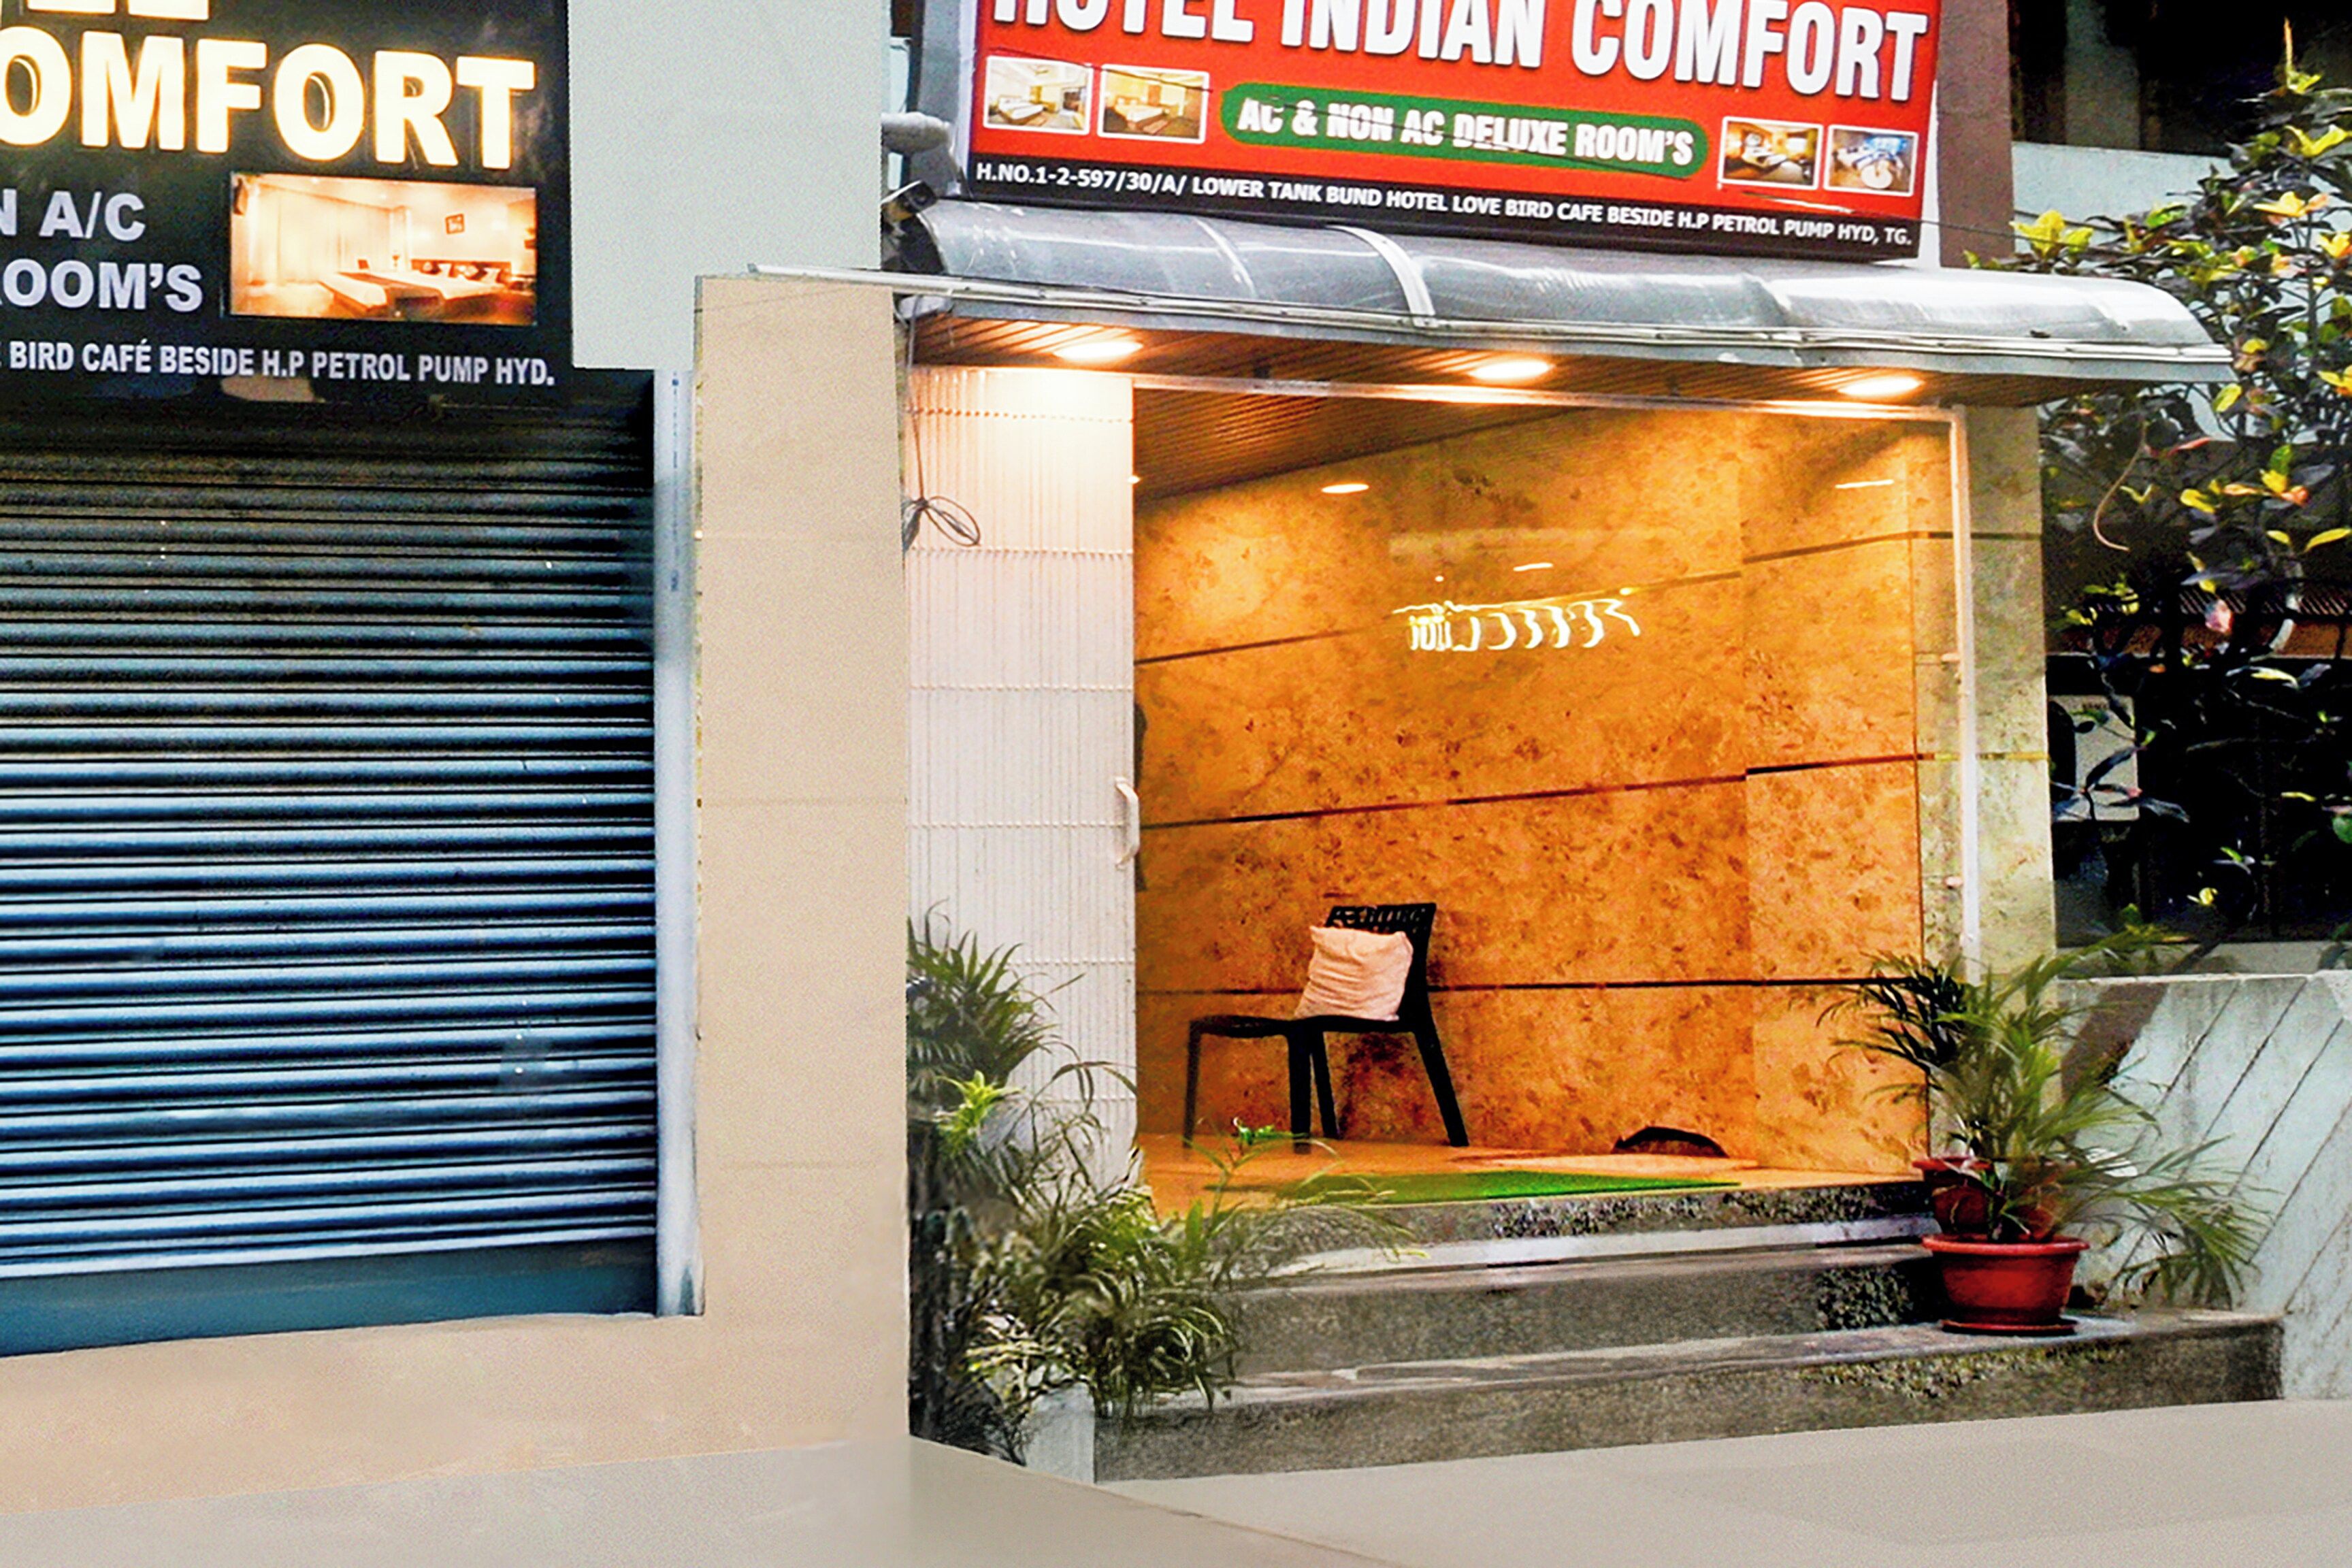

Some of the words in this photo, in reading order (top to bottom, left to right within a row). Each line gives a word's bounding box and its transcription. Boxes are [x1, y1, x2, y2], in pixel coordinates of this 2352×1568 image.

[1281, 0, 1544, 68] INDIAN
[1571, 0, 1928, 101] COMFORT
[1237, 97, 1284, 133] AC
[1292, 99, 1318, 136] &
[1326, 103, 1394, 141] NON
[1400, 109, 1446, 146] AC
[1453, 113, 1568, 155] DELUXE
[1573, 123, 1694, 165] ROOM'S
[39, 191, 146, 242] A/C
[1192, 176, 1264, 198] LOWER
[1268, 181, 1322, 202] TANK
[1326, 185, 1382, 206] BUND
[1386, 190, 1448, 212] HOTEL
[1452, 195, 1501, 215] LOVE
[1505, 199, 1554, 219] BIRD
[1557, 203, 1602, 222] CAFE
[1607, 206, 1673, 227] BESIDE
[1678, 210, 1709, 229] H.P
[1712, 214, 1780, 235] PETROL
[1784, 218, 1835, 238] PUMP
[1838, 223, 1880, 245] HYD,
[1884, 227, 1912, 245] TG.
[0, 258, 203, 312] OOM'S
[10, 341, 74, 370] BIRD
[82, 338, 152, 372] CAFÉ
[160, 345, 255, 375] BESIDE
[262, 349, 304, 377] H.P
[312, 351, 410, 381] PETROL
[419, 355, 488, 383] PUMP
[495, 357, 555, 386] HYD.
